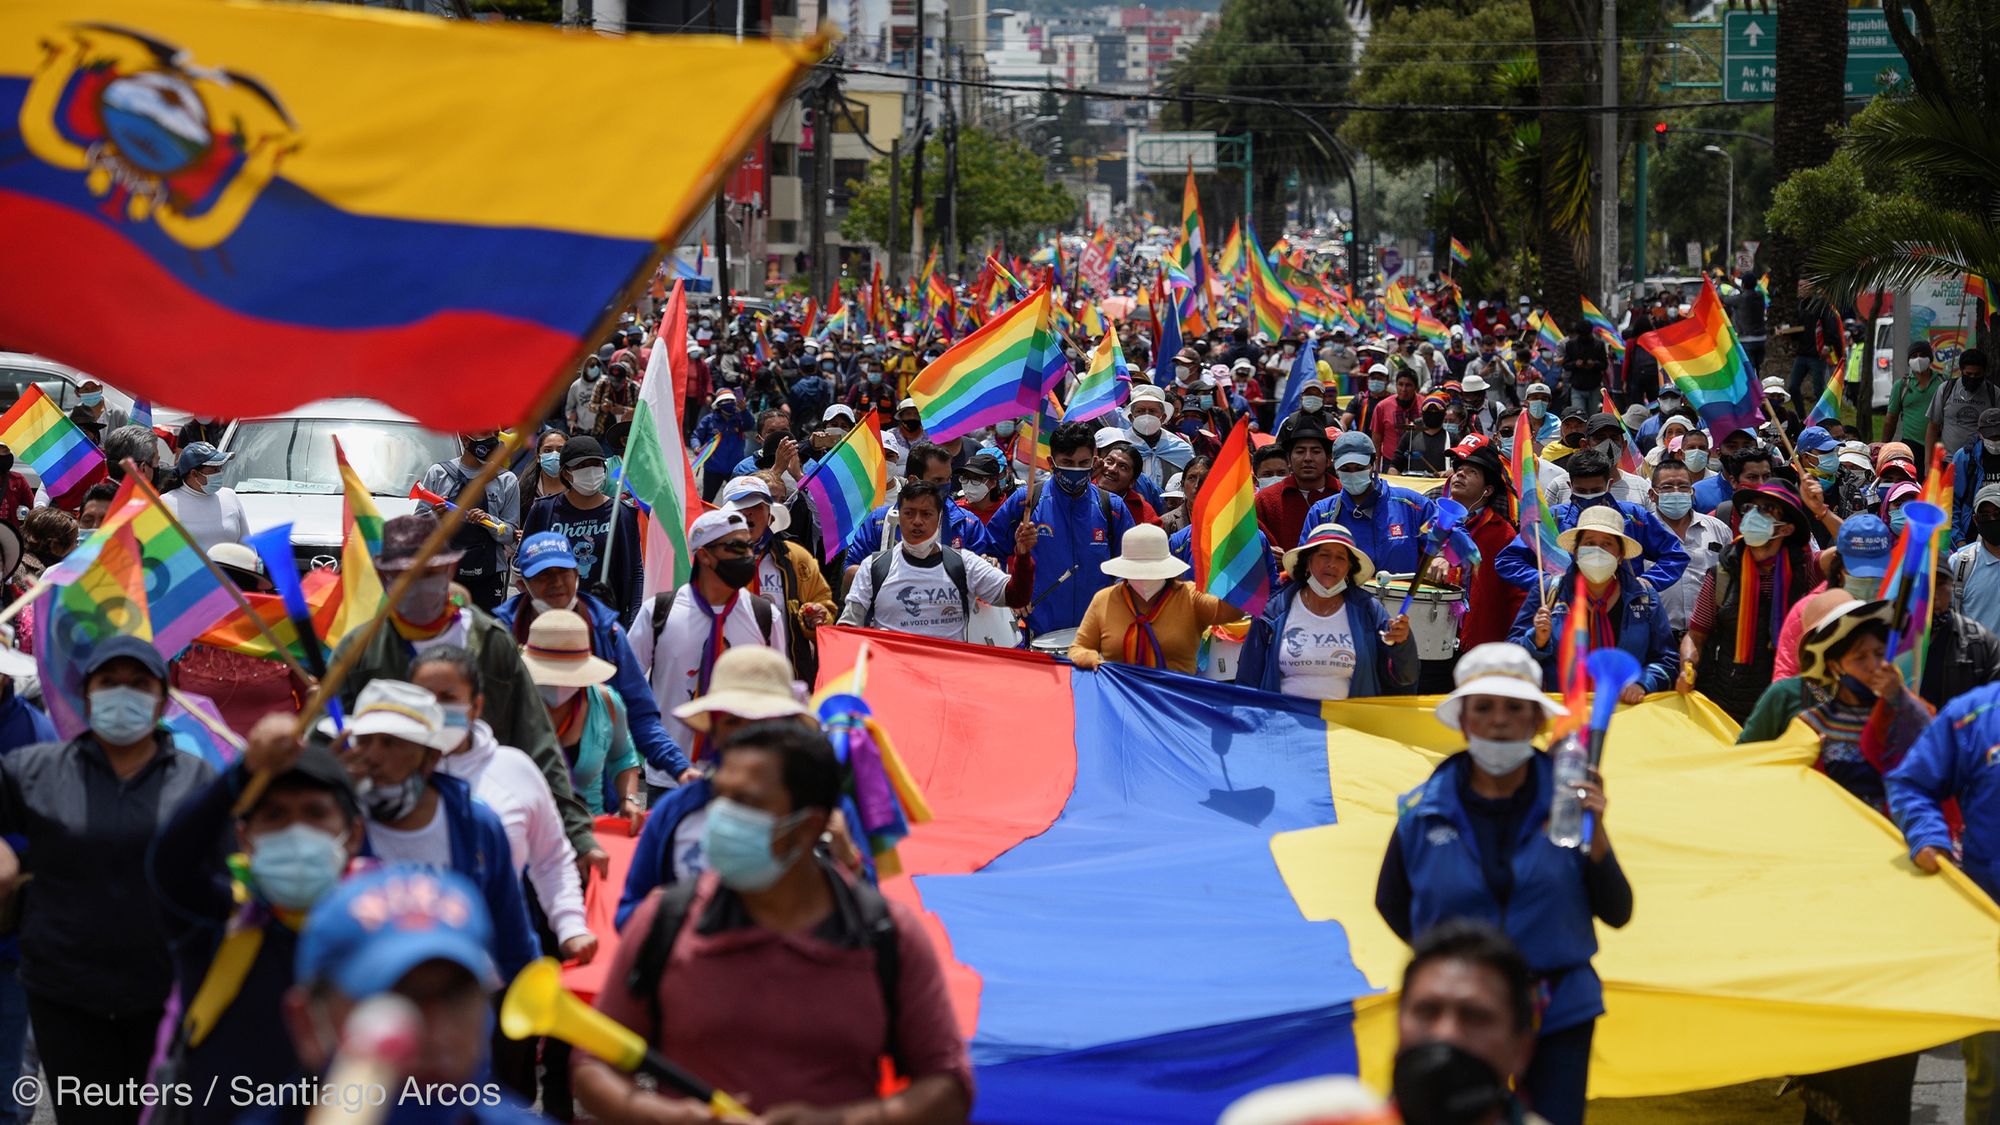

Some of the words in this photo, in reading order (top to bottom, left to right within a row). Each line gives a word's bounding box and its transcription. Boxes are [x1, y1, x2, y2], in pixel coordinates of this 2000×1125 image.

[1848, 36, 1888, 46] azonas
[1742, 65, 1759, 78] Av.
[1762, 65, 1777, 78] Po
[1742, 81, 1759, 92] Av.
[551, 521, 611, 538] Ohana
[924, 587, 960, 601] YAK
